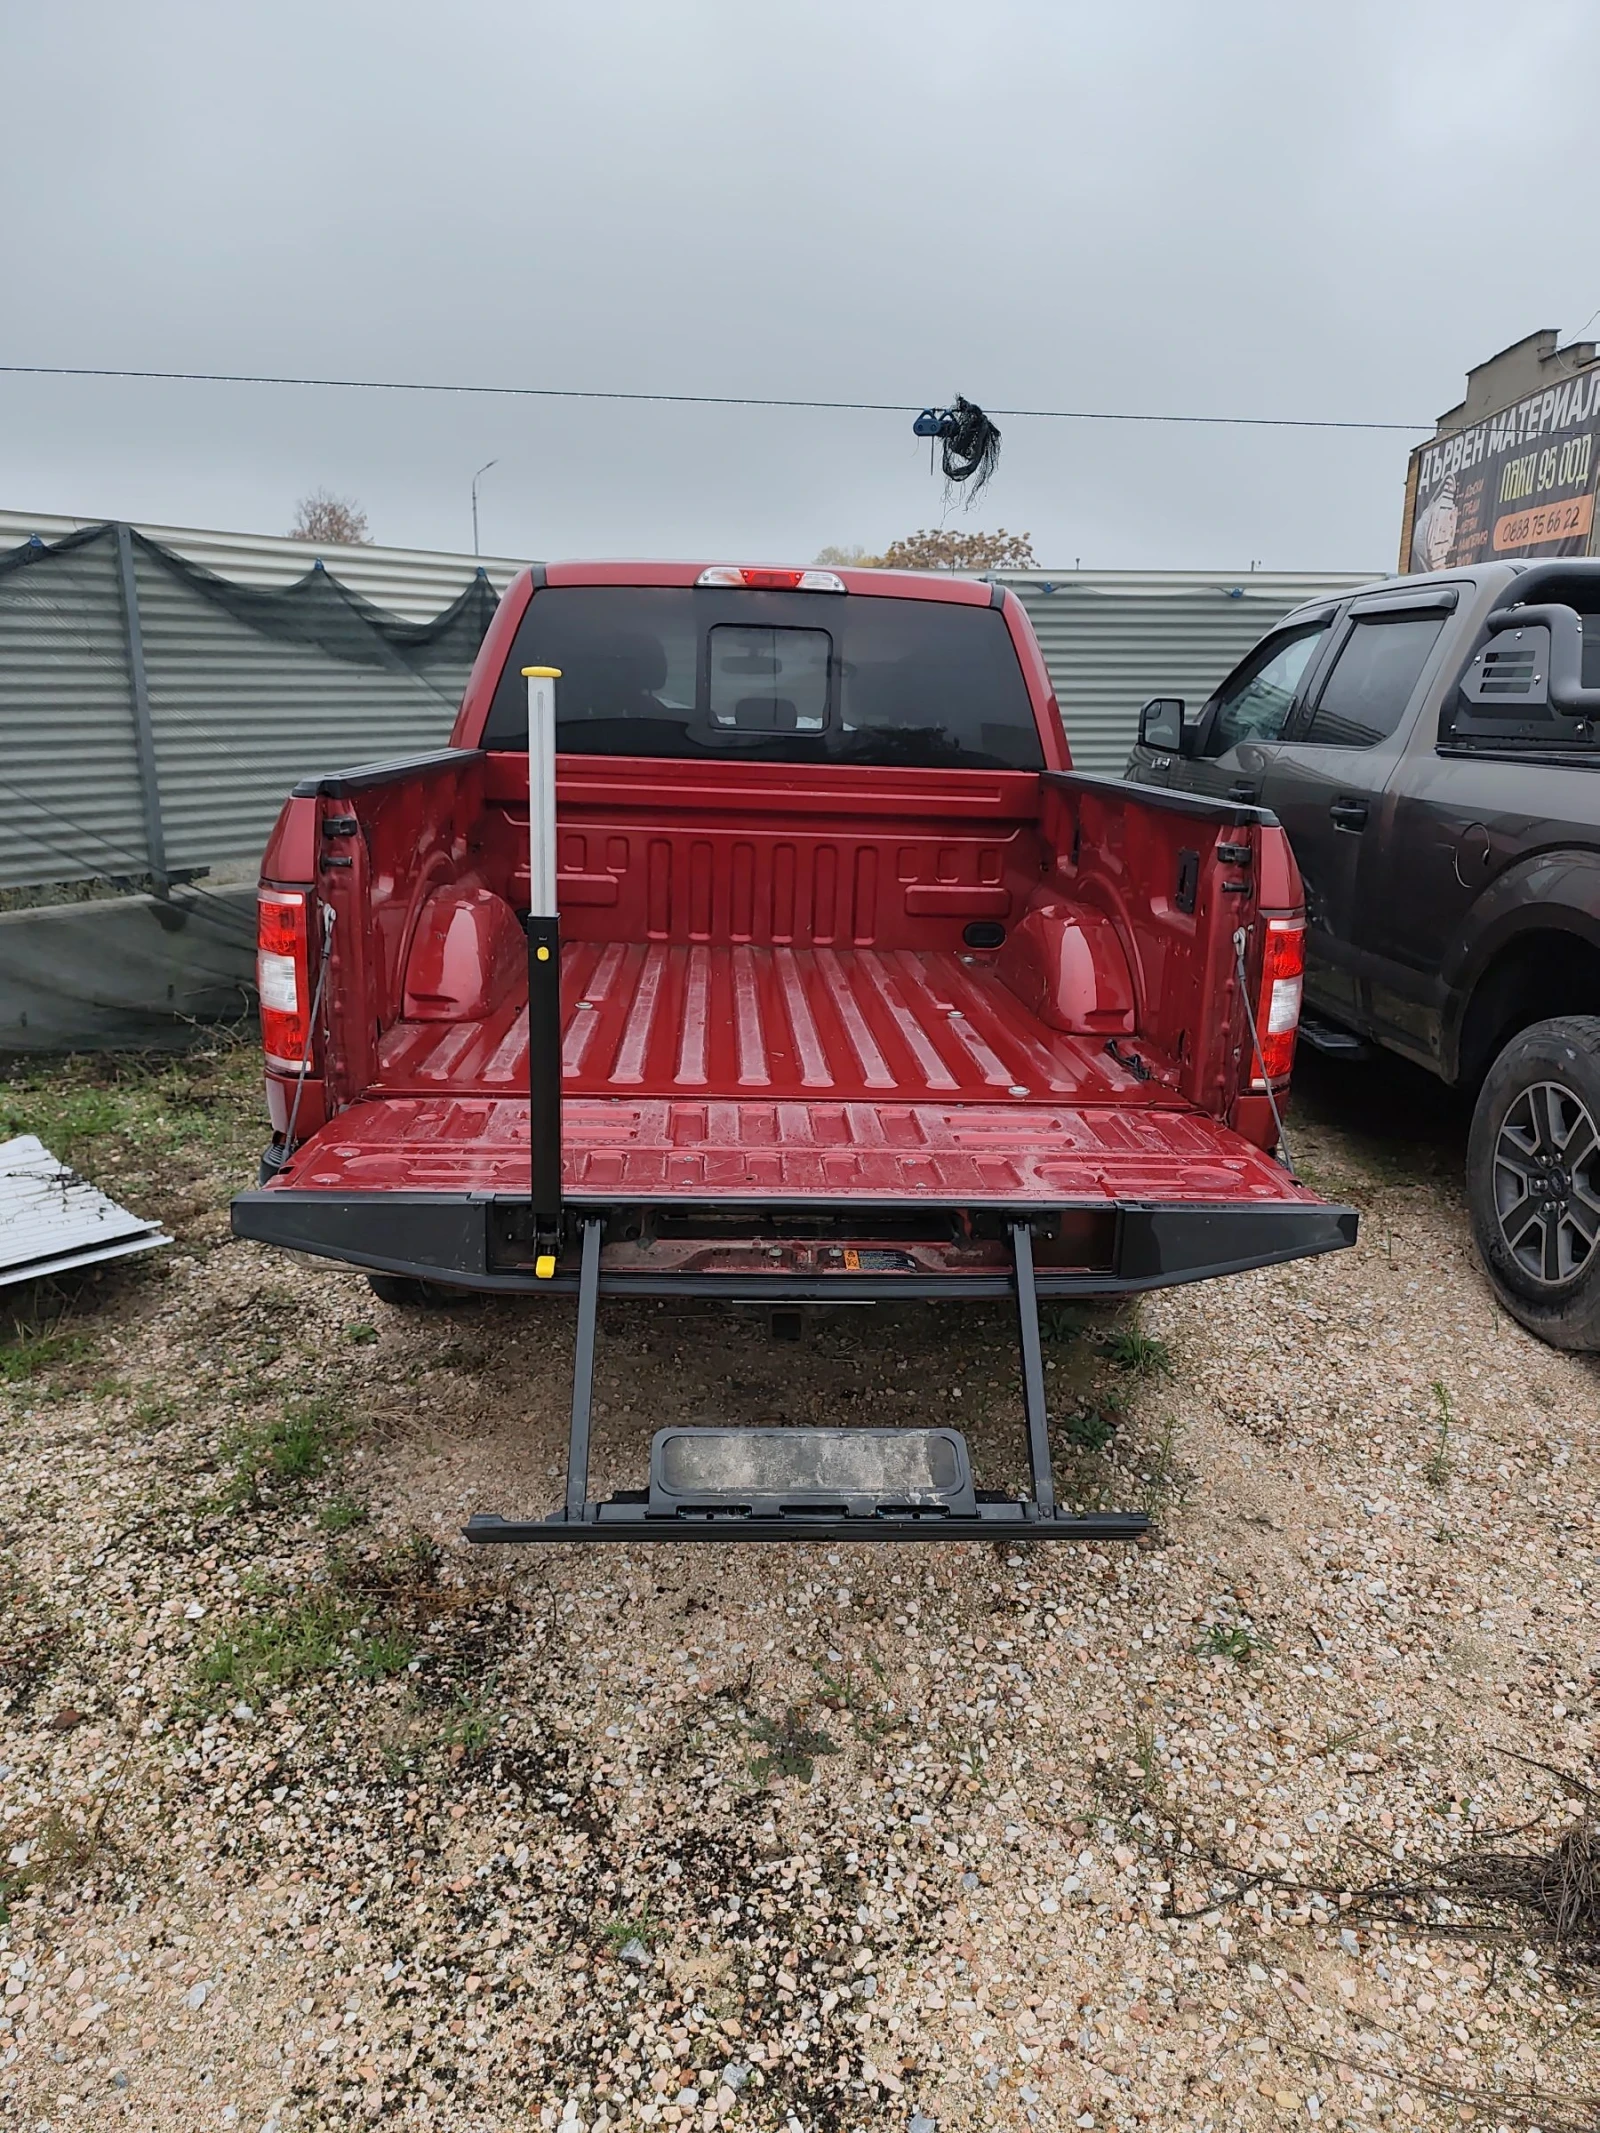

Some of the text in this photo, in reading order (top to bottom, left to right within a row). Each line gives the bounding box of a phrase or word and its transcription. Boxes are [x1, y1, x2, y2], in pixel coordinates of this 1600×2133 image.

[1418, 422, 1487, 495] ДЪРВЕН
[1537, 446, 1558, 492] 95
[1558, 433, 1592, 490] ООД
[1532, 514, 1546, 537] 75
[1563, 506, 1580, 530] 22
